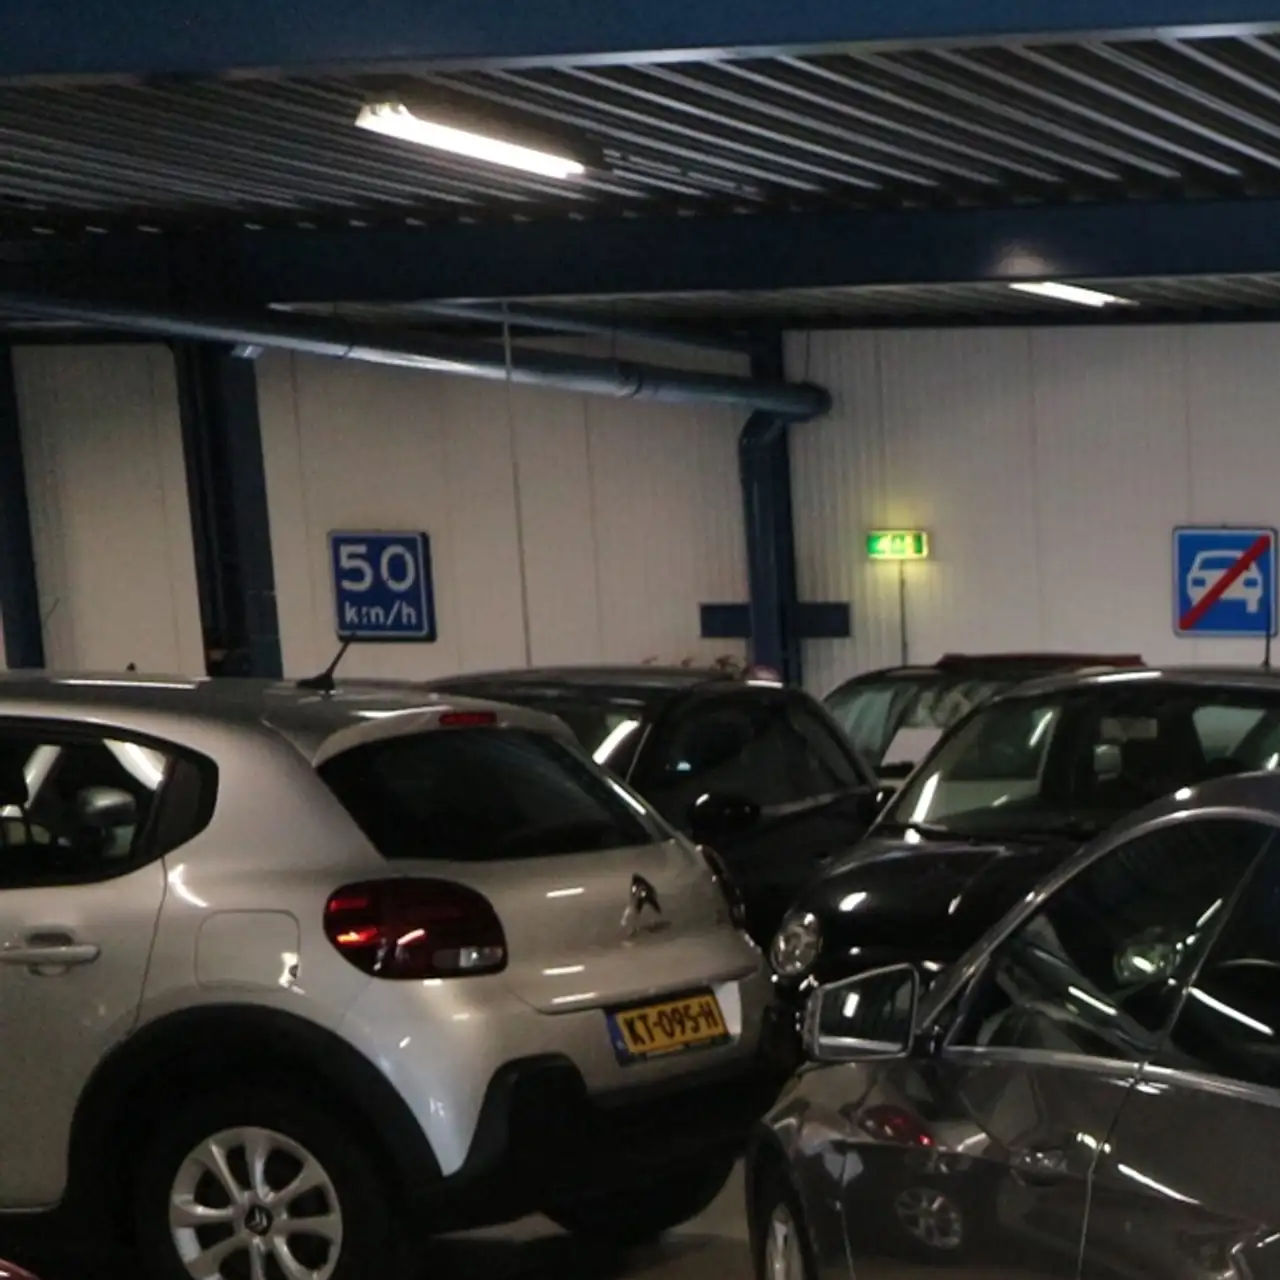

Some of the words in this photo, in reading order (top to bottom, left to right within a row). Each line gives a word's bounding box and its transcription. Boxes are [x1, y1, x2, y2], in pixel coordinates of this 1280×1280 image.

[340, 544, 416, 592] 50
[344, 599, 418, 627] km/h
[623, 1000, 720, 1046] KT-095-H
